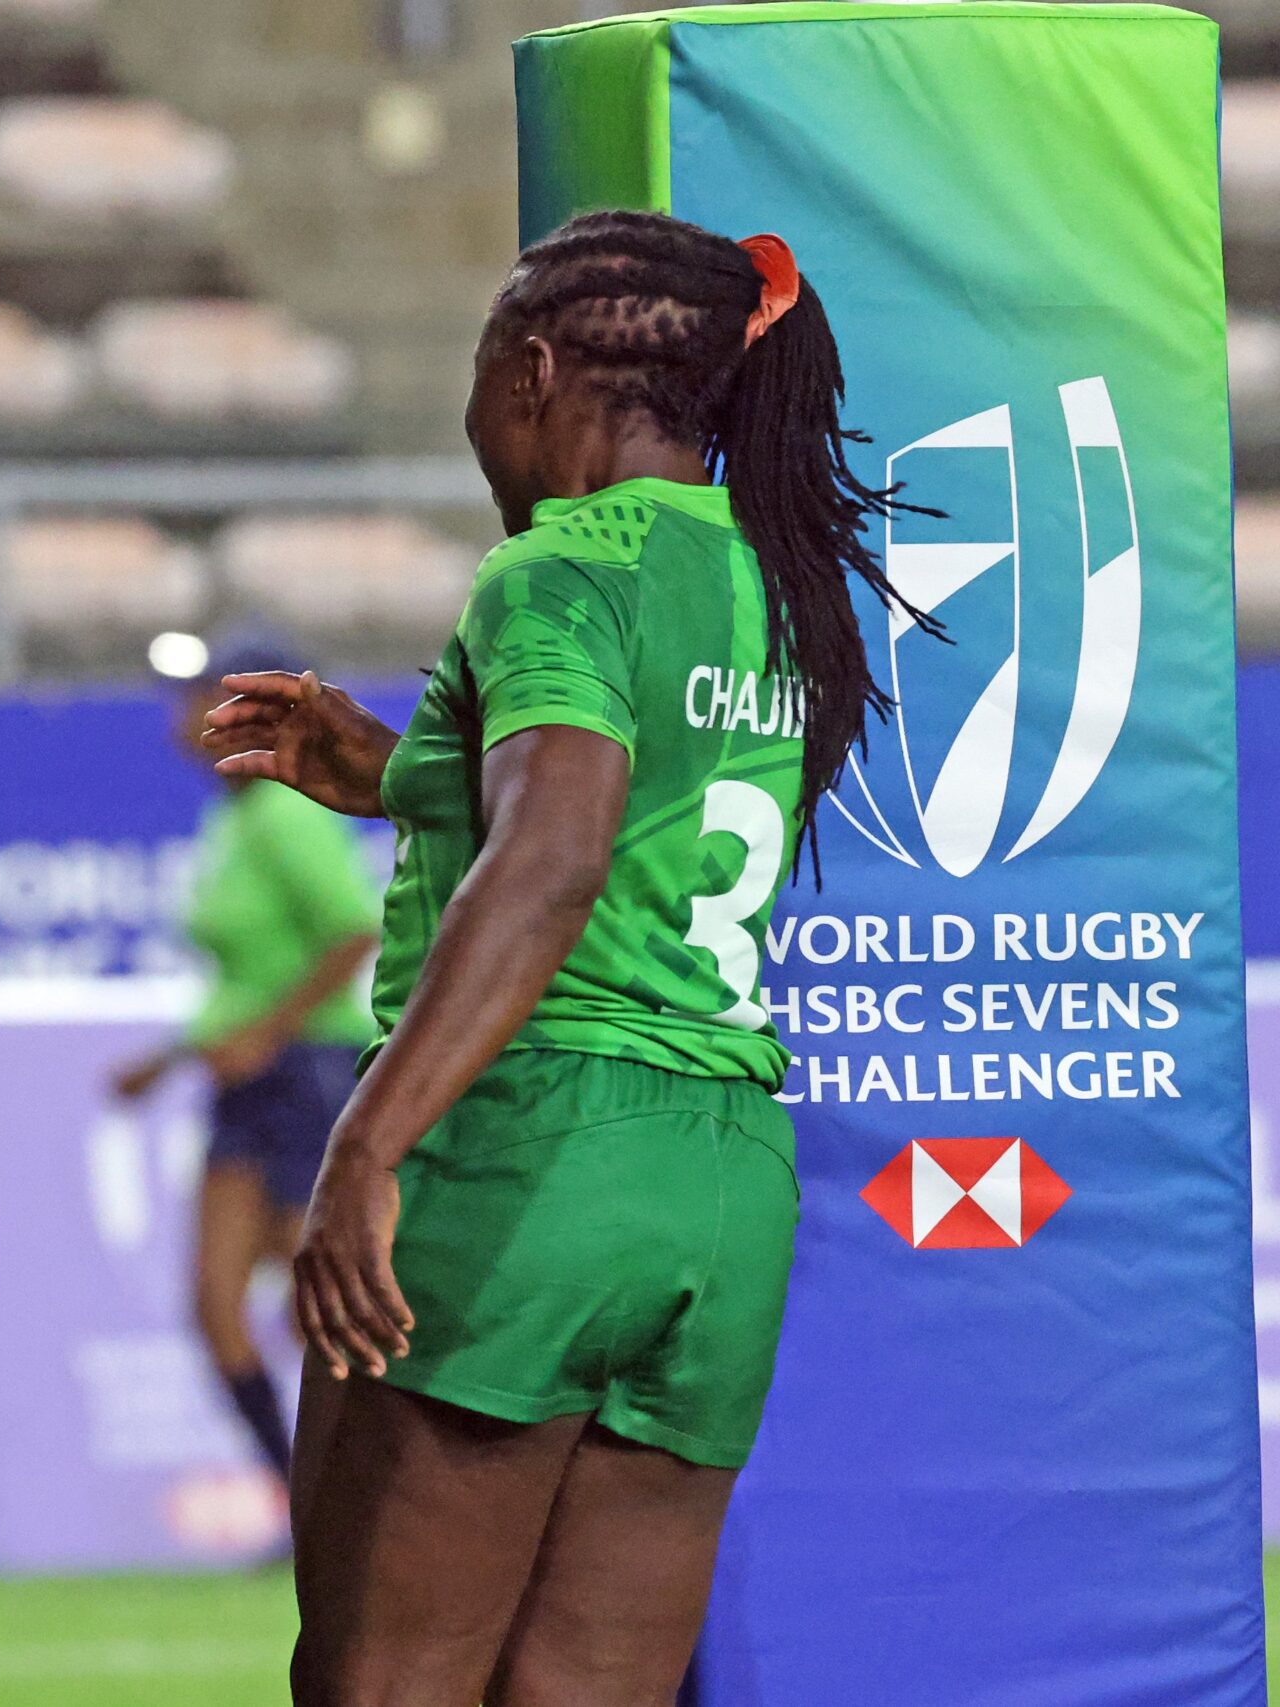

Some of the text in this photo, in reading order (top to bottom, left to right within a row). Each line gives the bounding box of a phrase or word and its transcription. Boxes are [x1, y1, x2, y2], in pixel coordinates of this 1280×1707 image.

[685, 664, 805, 738] CHAJI
[660, 780, 784, 1032] 3
[994, 912, 1205, 962] RUGBY
[760, 981, 1180, 1034] HSBC SEVENS
